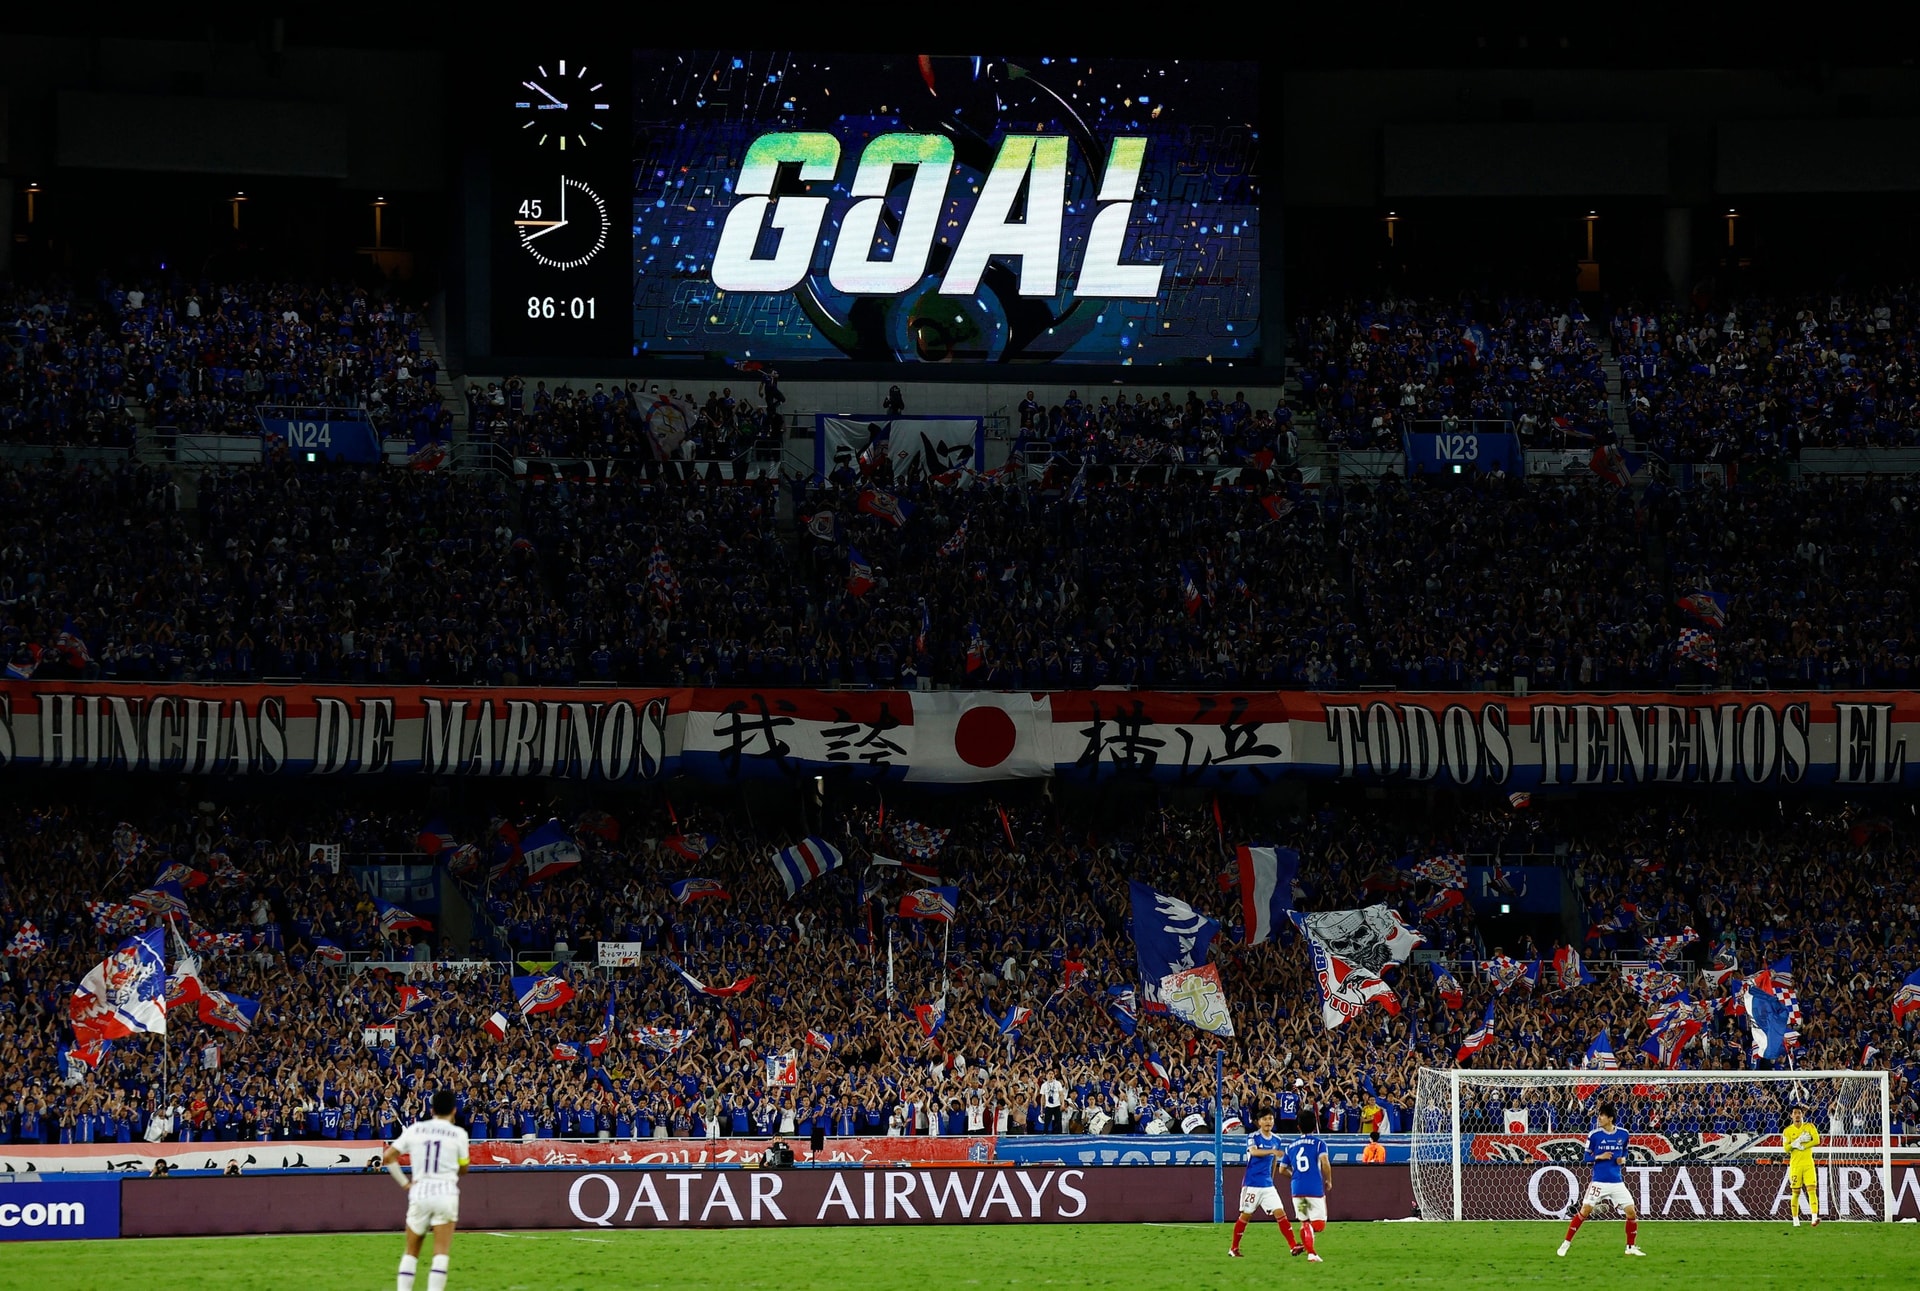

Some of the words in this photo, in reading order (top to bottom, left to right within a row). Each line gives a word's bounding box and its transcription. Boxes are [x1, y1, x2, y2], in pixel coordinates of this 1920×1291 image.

[518, 199, 543, 219] 45
[711, 132, 1165, 299] GOAL
[527, 297, 597, 320] 86:01
[287, 421, 331, 448] N24
[1434, 434, 1479, 462] N23
[36, 694, 288, 776] HINCHAS
[312, 696, 395, 776] DE
[421, 698, 670, 780] MARINOS
[1326, 700, 1510, 786] TODOS
[1530, 702, 1810, 786] TENEMOS
[1834, 702, 1906, 785] EL
[788, 1072, 794, 1082] 6
[324, 1116, 336, 1128] 14
[423, 1139, 441, 1174] 11
[1295, 1146, 1310, 1173] 6
[568, 1173, 787, 1227] QATAR
[816, 1170, 1087, 1222] AIRWAYS
[1244, 1193, 1256, 1204] 28
[1527, 1165, 1747, 1217] QTAR
[1589, 1185, 1602, 1197] 35
